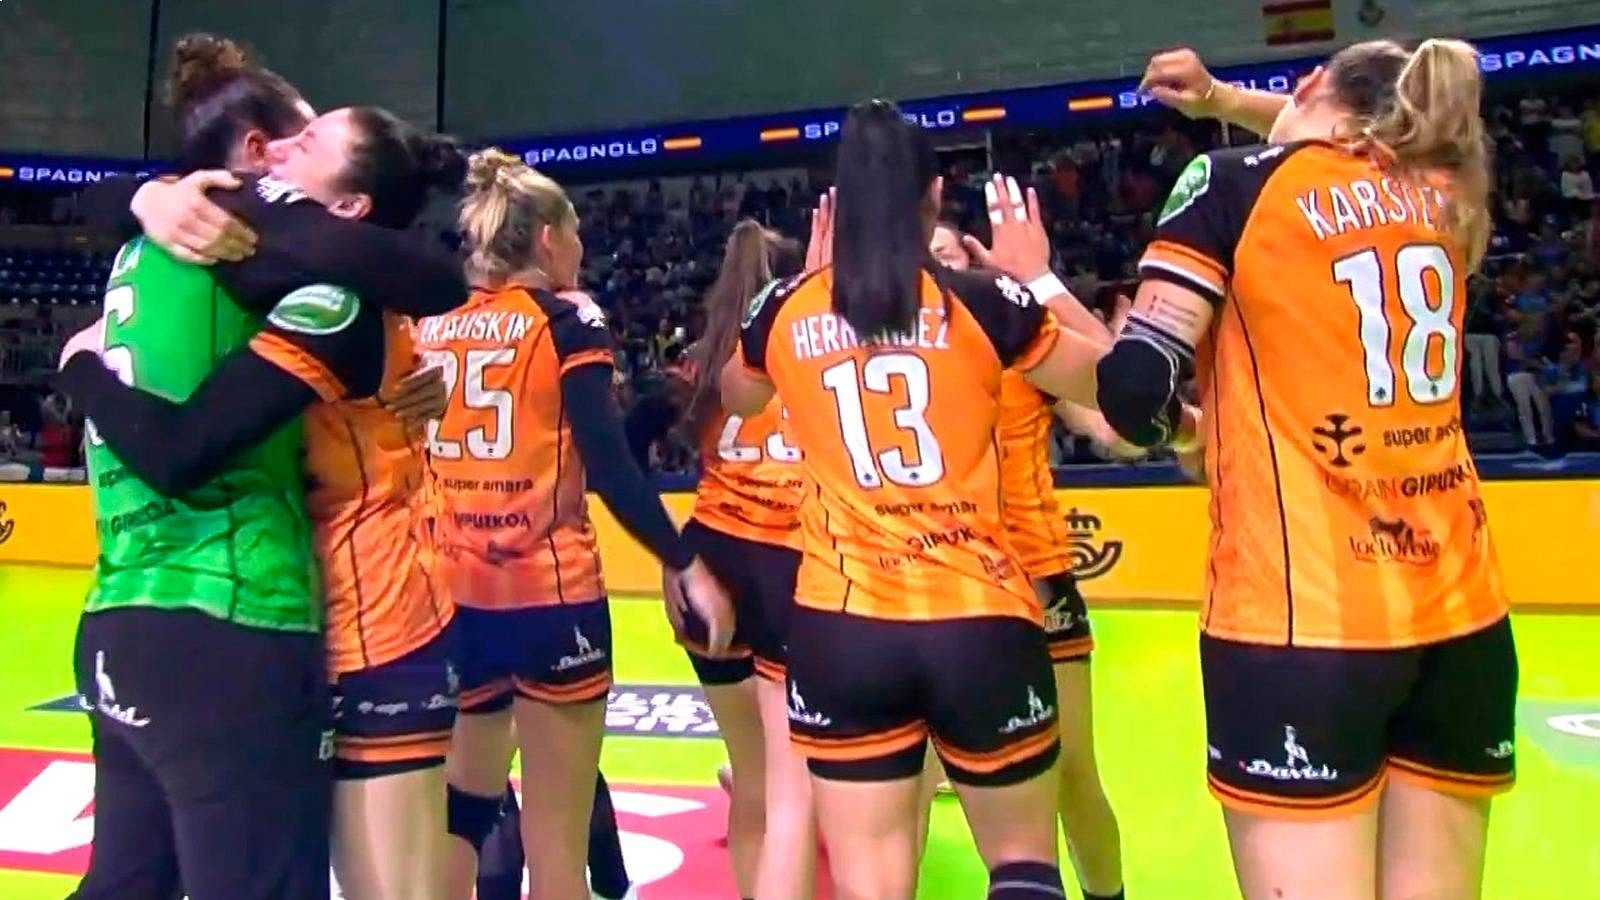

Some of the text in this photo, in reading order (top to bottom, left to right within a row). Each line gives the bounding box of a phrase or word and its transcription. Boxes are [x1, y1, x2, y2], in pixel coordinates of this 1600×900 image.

[1480, 43, 1600, 72] SPAGN
[19, 166, 150, 183] SPAGN
[525, 138, 657, 166] SPAGNOLO
[1333, 243, 1458, 407] 18
[420, 347, 517, 460] 25
[823, 353, 945, 488] 13
